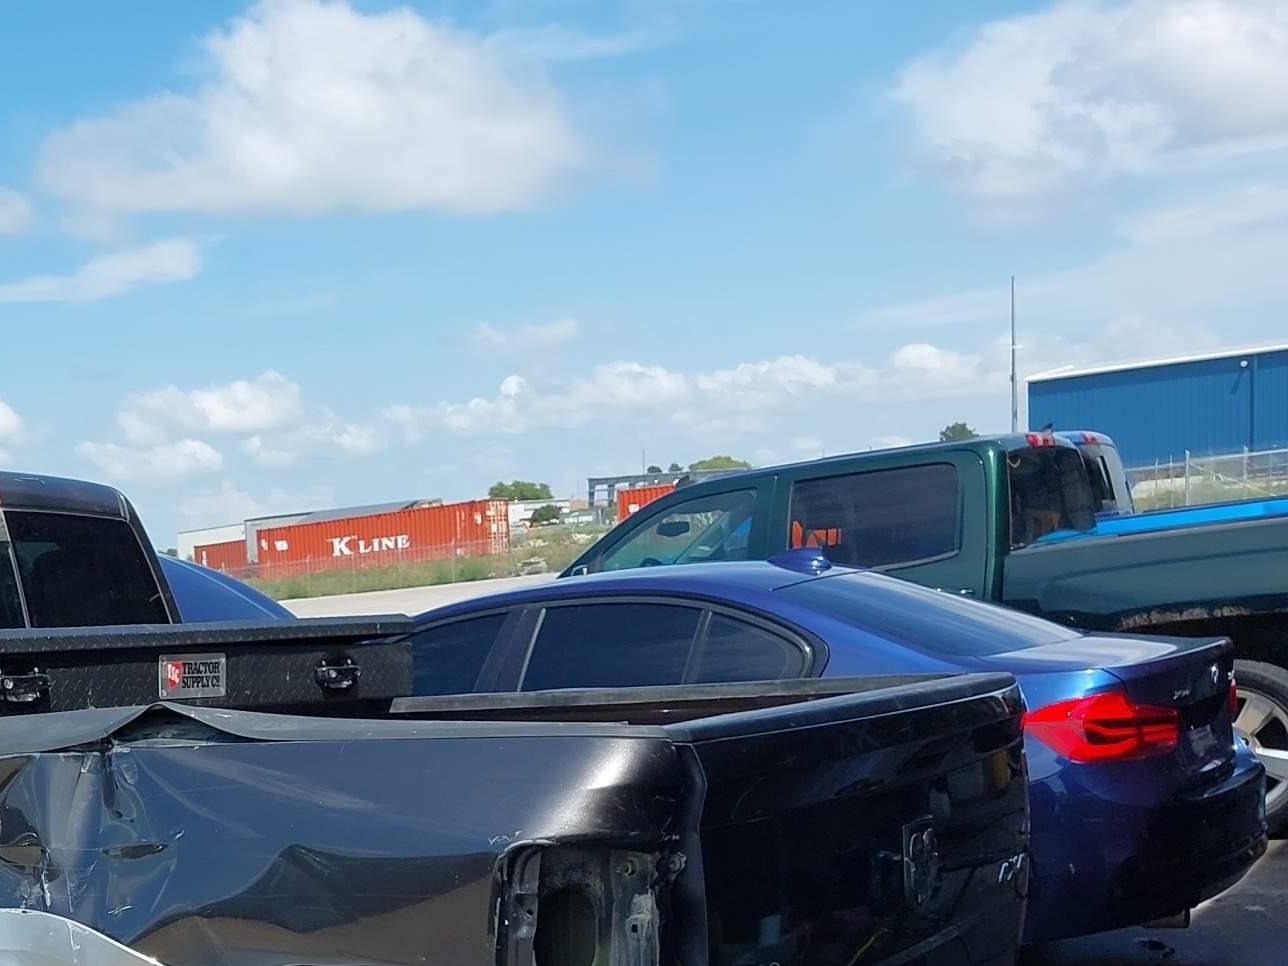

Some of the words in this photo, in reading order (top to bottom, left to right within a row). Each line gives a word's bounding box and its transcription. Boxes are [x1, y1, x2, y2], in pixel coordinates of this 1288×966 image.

[358, 534, 410, 554] LINE
[182, 662, 220, 674] TRACTOR
[182, 675, 210, 688] SUPPLY
